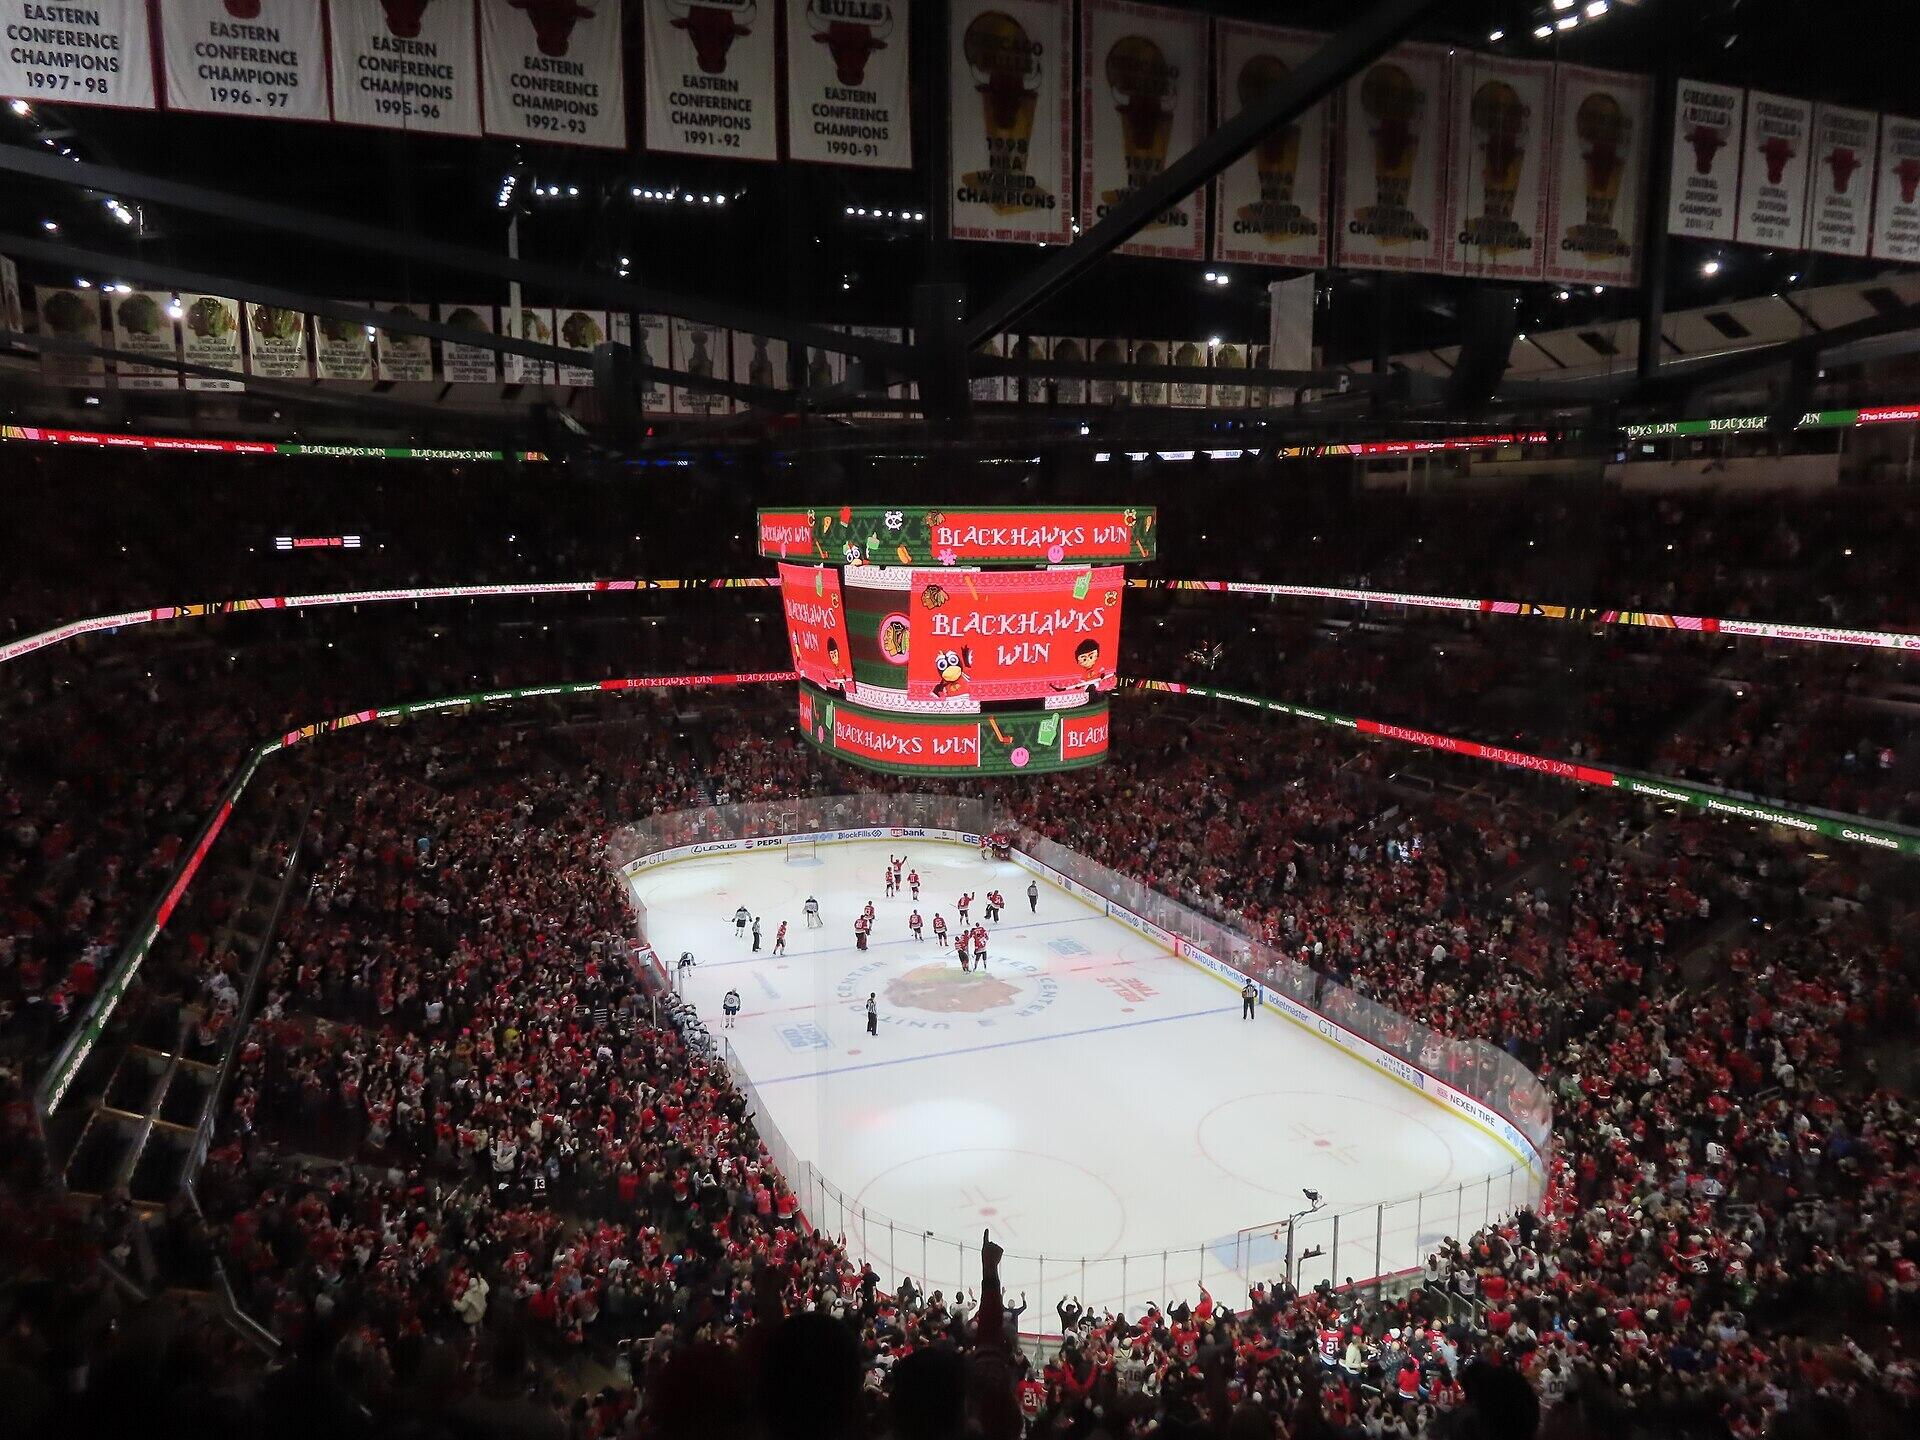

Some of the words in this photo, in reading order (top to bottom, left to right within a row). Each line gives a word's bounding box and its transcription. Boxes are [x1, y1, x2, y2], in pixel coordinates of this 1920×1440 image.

[24, 4, 100, 25] EASTERN
[7, 24, 118, 50] CONFERENCE
[210, 22, 280, 42] EASTERN
[196, 42, 298, 66] CONFERENCE
[373, 36, 437, 56] EASTERN
[11, 48, 119, 73] CHAMPIONS
[358, 56, 453, 79] CONFERENCE
[524, 56, 584, 76] EASTERN
[199, 65, 298, 87] CHAMPIONS
[511, 74, 598, 97] CONFERENCE
[683, 75, 738, 92] EASTERN
[361, 77, 452, 100] CHAMPIONS
[825, 86, 877, 104] EASTERN
[376, 100, 440, 118] 1995-96
[512, 94, 598, 117] CHAMPIONS
[670, 93, 752, 112] CONFERENCE
[672, 111, 751, 130] CHAMPIONS
[812, 104, 888, 122] CONFERENCE
[525, 114, 586, 133] 1992-93
[814, 122, 888, 140] CHAMPIONS
[684, 131, 740, 147] 1991-92
[827, 141, 878, 156] 1990-91
[958, 188, 1055, 209] CHAMPIONS
[1680, 204, 1722, 217] CHAMPIONS
[1878, 411, 1919, 420] Holidays
[300, 445, 365, 456] BLACKHAWKS
[368, 448, 386, 456] WIN
[412, 449, 472, 460] BLACKHAWKS
[795, 525, 812, 543] WIN
[937, 525, 1086, 548] BLACKHAWKS
[1094, 526, 1128, 544] WIN
[932, 607, 1105, 636] BLACKHAWKS
[1730, 625, 1757, 633] Center
[803, 634, 819, 652] WIN
[1776, 630, 1803, 638] Home
[1804, 632, 1819, 640] For
[1821, 633, 1838, 641] The
[1840, 635, 1881, 645] Holidays
[997, 643, 1051, 666] WIN
[627, 677, 690, 687] BLACKHAWKS
[695, 676, 713, 684] WIN
[736, 672, 796, 682] BLACKHAWKS
[446, 698, 471, 706] Holidays
[1335, 718, 1349, 726] Home
[837, 722, 923, 756] BLACKHAWKS
[932, 737, 977, 756] WIN
[1378, 724, 1435, 746] BLACKHAWKS
[1438, 738, 1457, 749] WIN
[1480, 746, 1548, 771] BLACKHAWKS
[1553, 762, 1575, 773] WIN
[1633, 783, 1661, 796] United
[1661, 789, 1690, 802] Center
[1708, 800, 1736, 813] Home
[1737, 806, 1754, 817] For
[1754, 810, 1773, 821] The
[1774, 814, 1818, 831] Holidays
[757, 839, 782, 847] PEPSI
[838, 832, 872, 840] BlockFills
[963, 835, 979, 844] GE
[1842, 830, 1859, 840] Go
[1860, 833, 1898, 849] Hawks
[703, 842, 737, 852] LEXUS
[649, 852, 667, 865] GTL
[1111, 905, 1135, 924] BlockFills
[1192, 951, 1218, 971] FANDUEL
[1269, 995, 1310, 1022] ticketmaster
[1319, 1019, 1341, 1043] GTL
[1376, 1059, 1411, 1081] AIRLINES
[1383, 1056, 1411, 1073] UNITED
[1450, 1094, 1477, 1115] NEXEN
[1478, 1109, 1496, 1127] TIRE
[534, 1178, 546, 1190] 13
